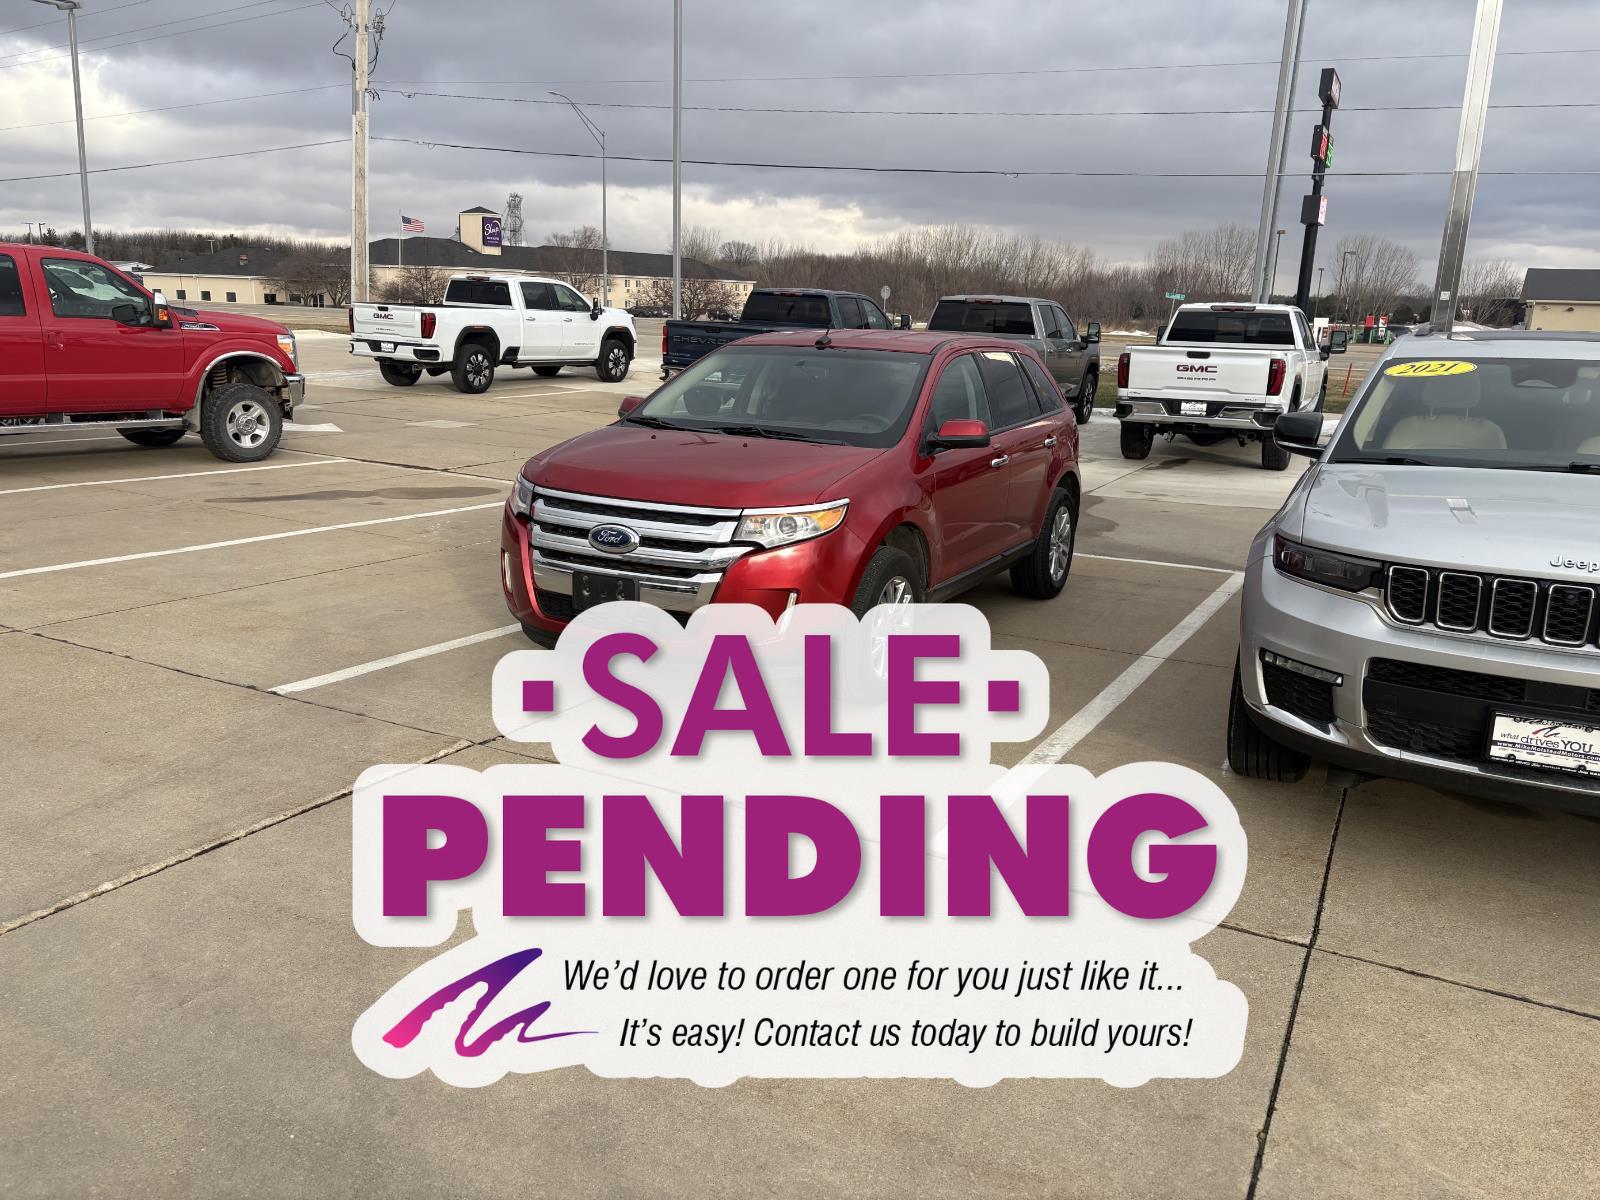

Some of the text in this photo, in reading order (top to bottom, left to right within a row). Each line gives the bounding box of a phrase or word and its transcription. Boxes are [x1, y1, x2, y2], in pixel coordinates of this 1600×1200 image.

[1176, 364, 1218, 373] GMC
[1396, 363, 1459, 375] 2021
[597, 529, 623, 544] Ford
[1550, 555, 1600, 573] Jeep
[1500, 732, 1519, 740] what
[1520, 735, 1560, 749] drives
